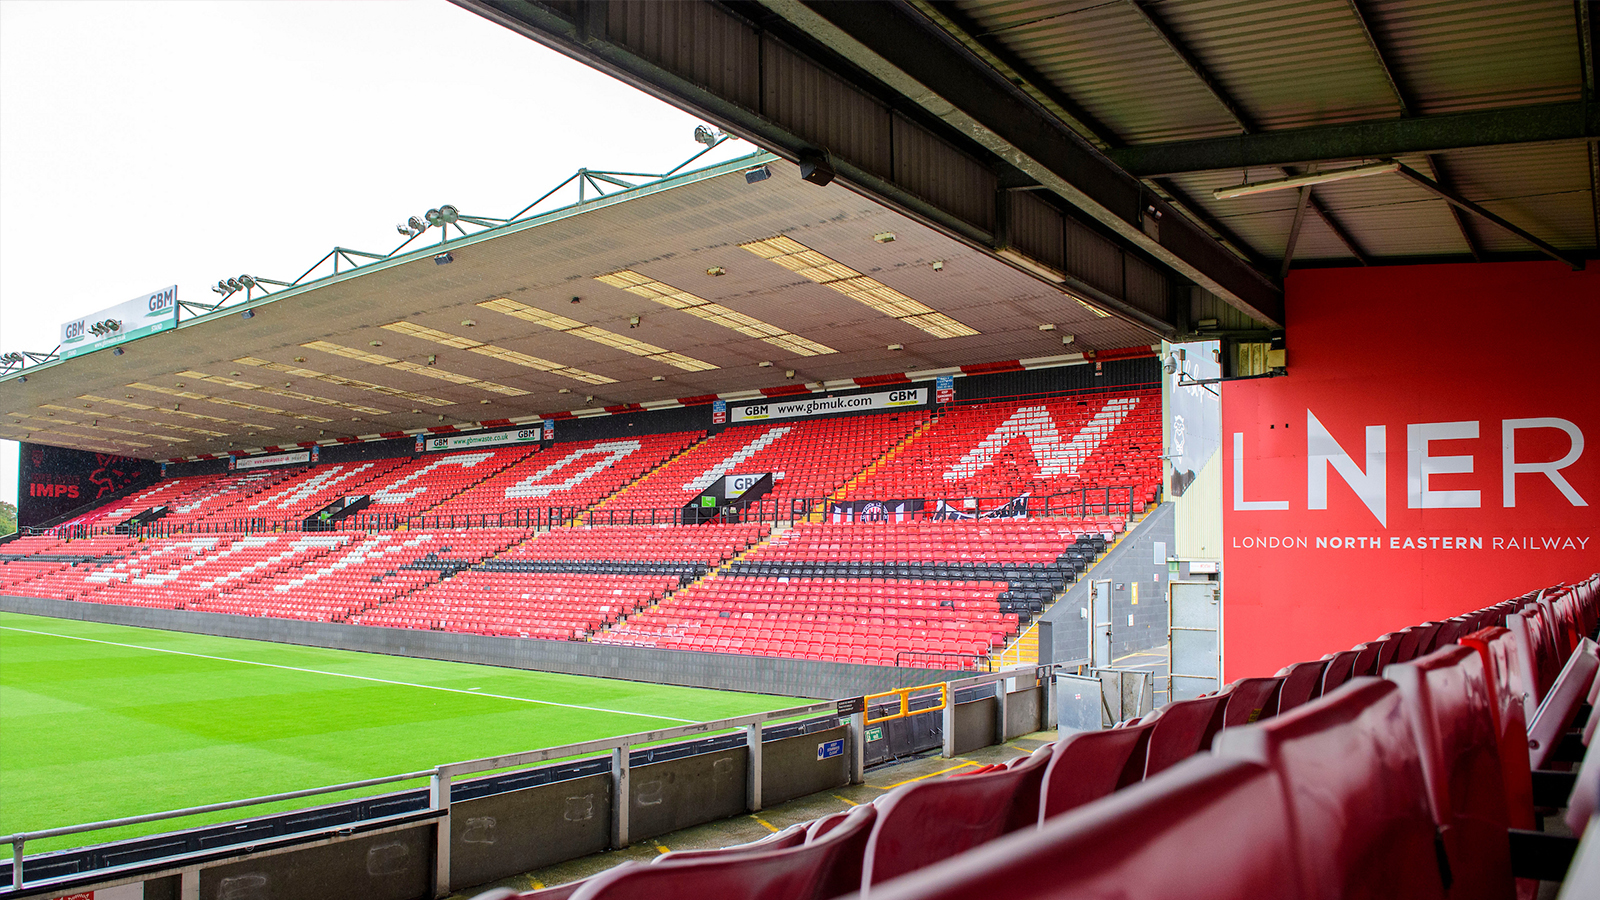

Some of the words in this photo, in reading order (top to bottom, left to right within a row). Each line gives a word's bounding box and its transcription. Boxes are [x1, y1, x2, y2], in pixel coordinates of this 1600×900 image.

[148, 289, 173, 312] GBM
[65, 320, 85, 339] GBM
[744, 404, 769, 416] GBM
[777, 396, 872, 414] www.gbmuk.com
[889, 389, 918, 402] GBM
[433, 438, 449, 447] GBM
[517, 429, 535, 438] GBM
[1233, 408, 1589, 529] LNER
[29, 482, 80, 499] IMPS
[734, 477, 761, 490] GB
[1233, 536, 1308, 549] LONDON
[1316, 536, 1382, 549] NORTH
[1390, 536, 1483, 550] EASTERN
[1492, 536, 1590, 550] RAILWAY
